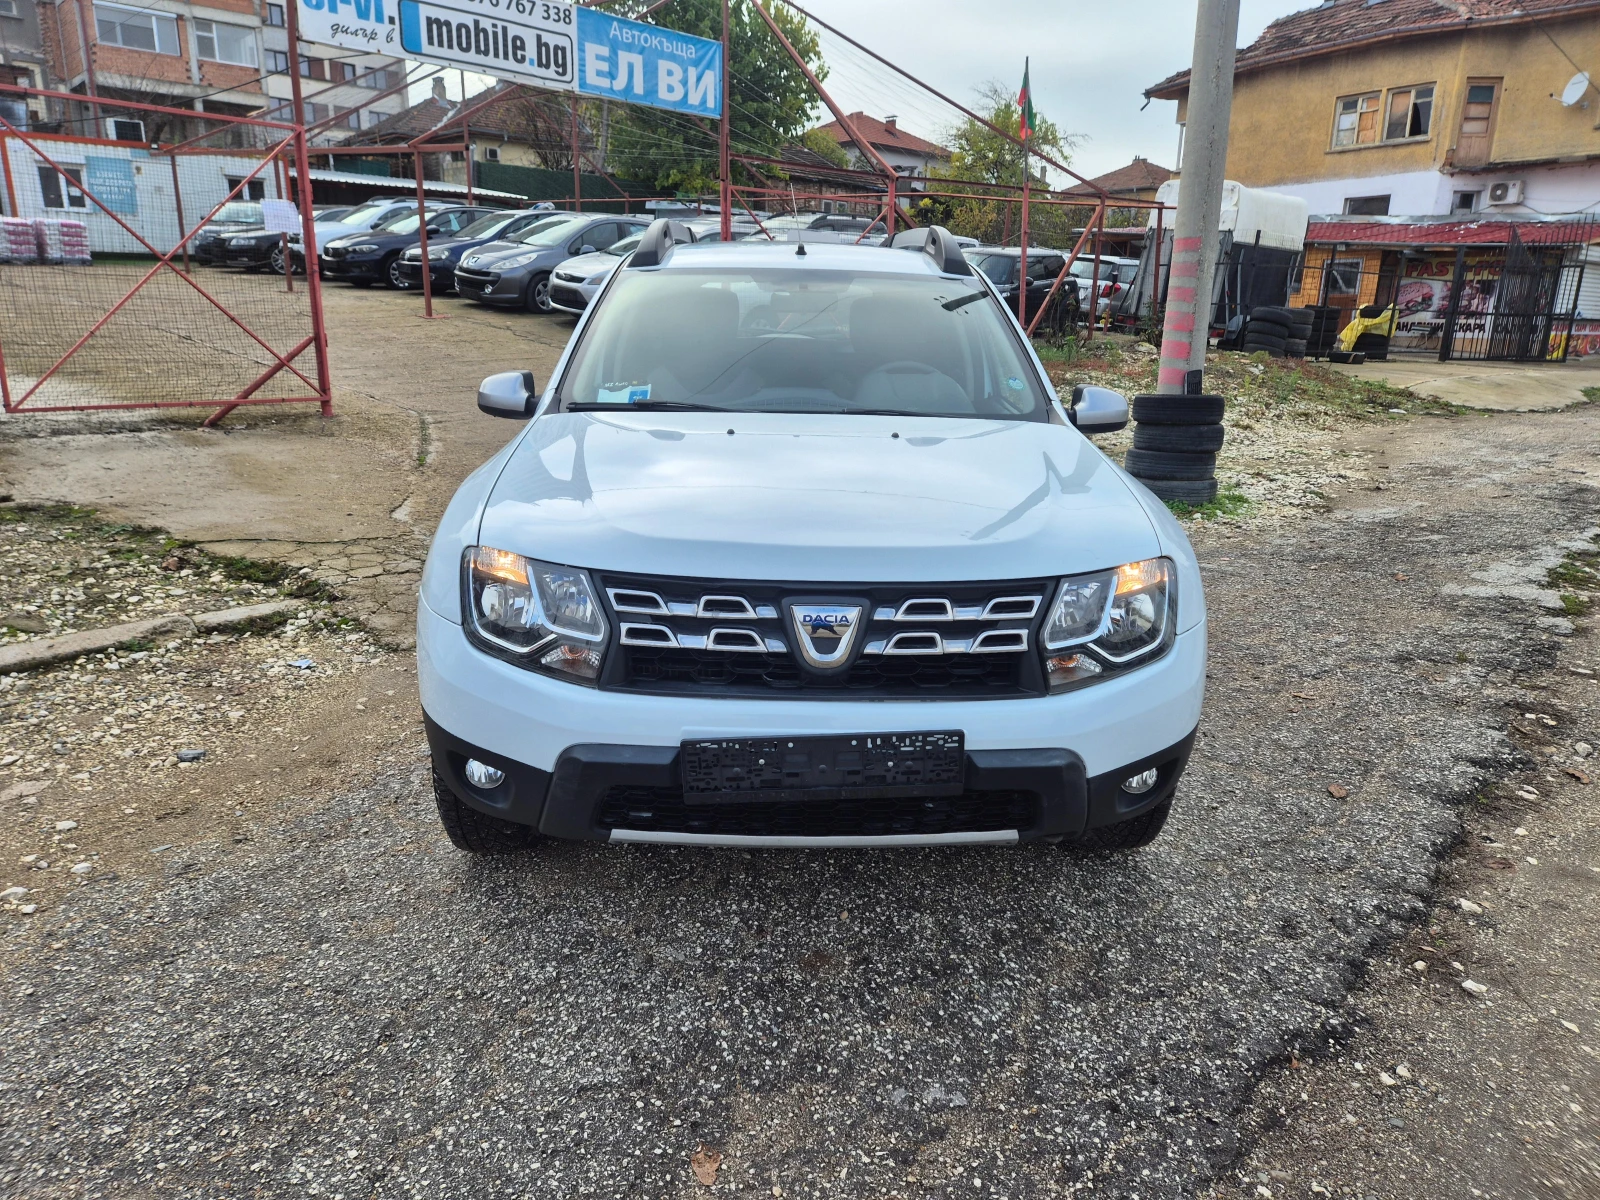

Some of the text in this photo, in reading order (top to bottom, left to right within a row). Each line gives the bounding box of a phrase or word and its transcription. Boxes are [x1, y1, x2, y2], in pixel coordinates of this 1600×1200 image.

[541, 3, 572, 25] 338
[330, 23, 378, 43] дилър
[425, 15, 568, 77] mobile.bg
[609, 21, 696, 59] Автокъща
[584, 42, 715, 109] ЕЛ ВИ
[802, 614, 850, 624] DACIA
